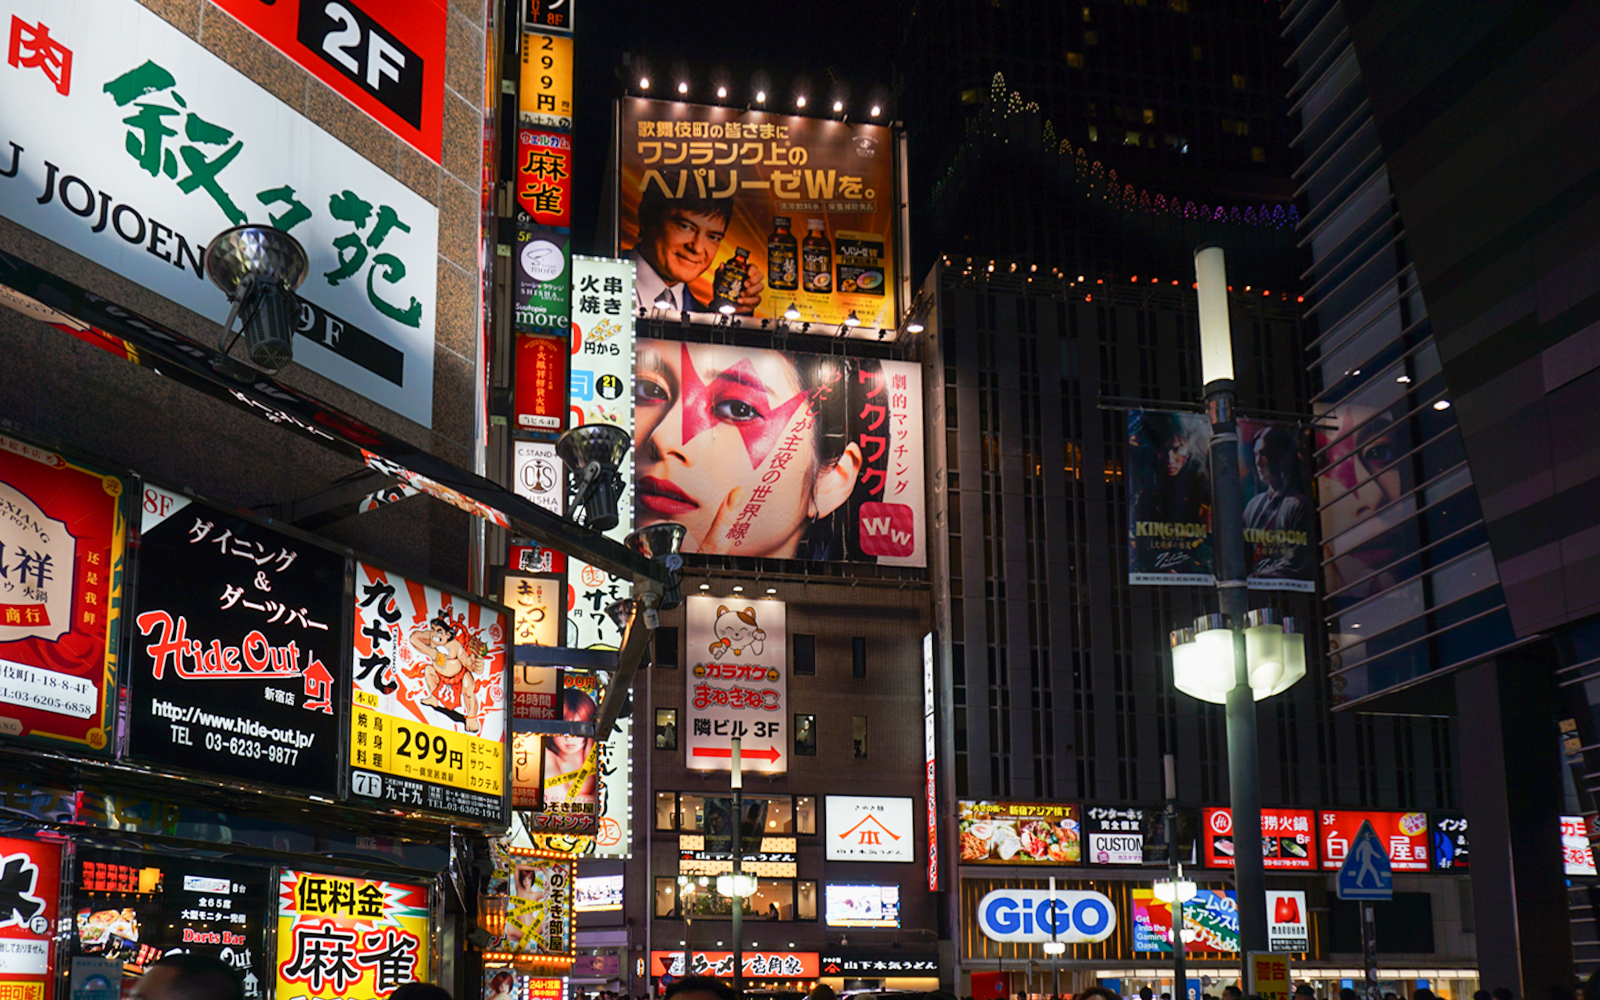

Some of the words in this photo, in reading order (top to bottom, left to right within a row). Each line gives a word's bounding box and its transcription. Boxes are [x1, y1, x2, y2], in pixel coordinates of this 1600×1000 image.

[547, 12, 563, 26] 8F
[8, 13, 73, 97] 肉
[321, 1, 406, 91] 2F
[523, 113, 556, 126] 九十九
[638, 121, 789, 139] 歌舞伎町の皆さまに
[520, 131, 571, 150] ウェルカム
[638, 141, 808, 165] ワンランク上の
[521, 150, 568, 215] 麻雀
[638, 169, 876, 199] ヘパリーゼWを。
[37, 160, 206, 280] JOJOEN
[517, 211, 532, 224] 6F
[517, 231, 533, 243] 5F
[298, 304, 346, 347] 9F
[515, 311, 568, 329] more
[858, 369, 888, 496] ワクワク
[891, 373, 909, 496] 劇的マッチング
[725, 367, 842, 548] わたしが主役の世界線。
[142, 488, 175, 519] 8F
[9, 514, 29, 531] POT
[1136, 521, 1208, 540] KINGDOM
[188, 516, 298, 573] ダイニング
[1243, 527, 1308, 546] KINGDOM
[254, 571, 272, 592] &
[23, 586, 48, 603] 火鍋
[5, 607, 41, 624] 商行
[219, 583, 329, 632] ダーツバー
[574, 609, 583, 617] 円
[583, 589, 608, 641] サワー
[137, 611, 241, 680] Hide
[243, 629, 301, 673] Out
[353, 577, 402, 696] 九十九
[0, 664, 90, 694] 伎町1-18-8-4F
[706, 663, 768, 681] カラオケ
[264, 686, 296, 706] 新宿店
[356, 691, 378, 708] 本店
[513, 693, 552, 707] 24時間
[693, 682, 781, 711] まねきねこ
[151, 698, 315, 749] http://www.hide-out.jp/
[693, 718, 748, 738] 隣ビル
[754, 721, 780, 738] 3F
[170, 724, 193, 747] TEL
[205, 731, 298, 767] 03-6233-9877
[396, 726, 464, 770] 299円
[469, 741, 500, 759] 生ビール
[470, 757, 493, 771] サワー
[357, 773, 381, 796] 7F
[470, 774, 500, 792] カクテル
[385, 787, 424, 806] 九十九
[1009, 805, 1072, 817] 新宿アジア横丁
[1323, 814, 1336, 825] 5F
[536, 814, 594, 829] マドンナ
[1100, 820, 1140, 831] 完全個室
[1261, 816, 1308, 832] 撈火鍋
[1296, 834, 1311, 845] 6F
[1438, 857, 1453, 868] 4F
[232, 882, 247, 894] 8台
[298, 876, 384, 917] 低料金
[198, 897, 232, 910] 全65席
[181, 909, 247, 924] 大型モニター完備
[549, 874, 564, 953] のぞき部屋
[985, 897, 1109, 935] GiGO
[183, 928, 221, 945] Darts
[222, 930, 246, 945] Bar
[1137, 934, 1167, 942] Gaming
[1271, 926, 1306, 935] MARUHAN
[284, 924, 416, 993] 麻雀
[844, 960, 938, 971] 山下本気うどん
[1256, 961, 1286, 981] 警告
